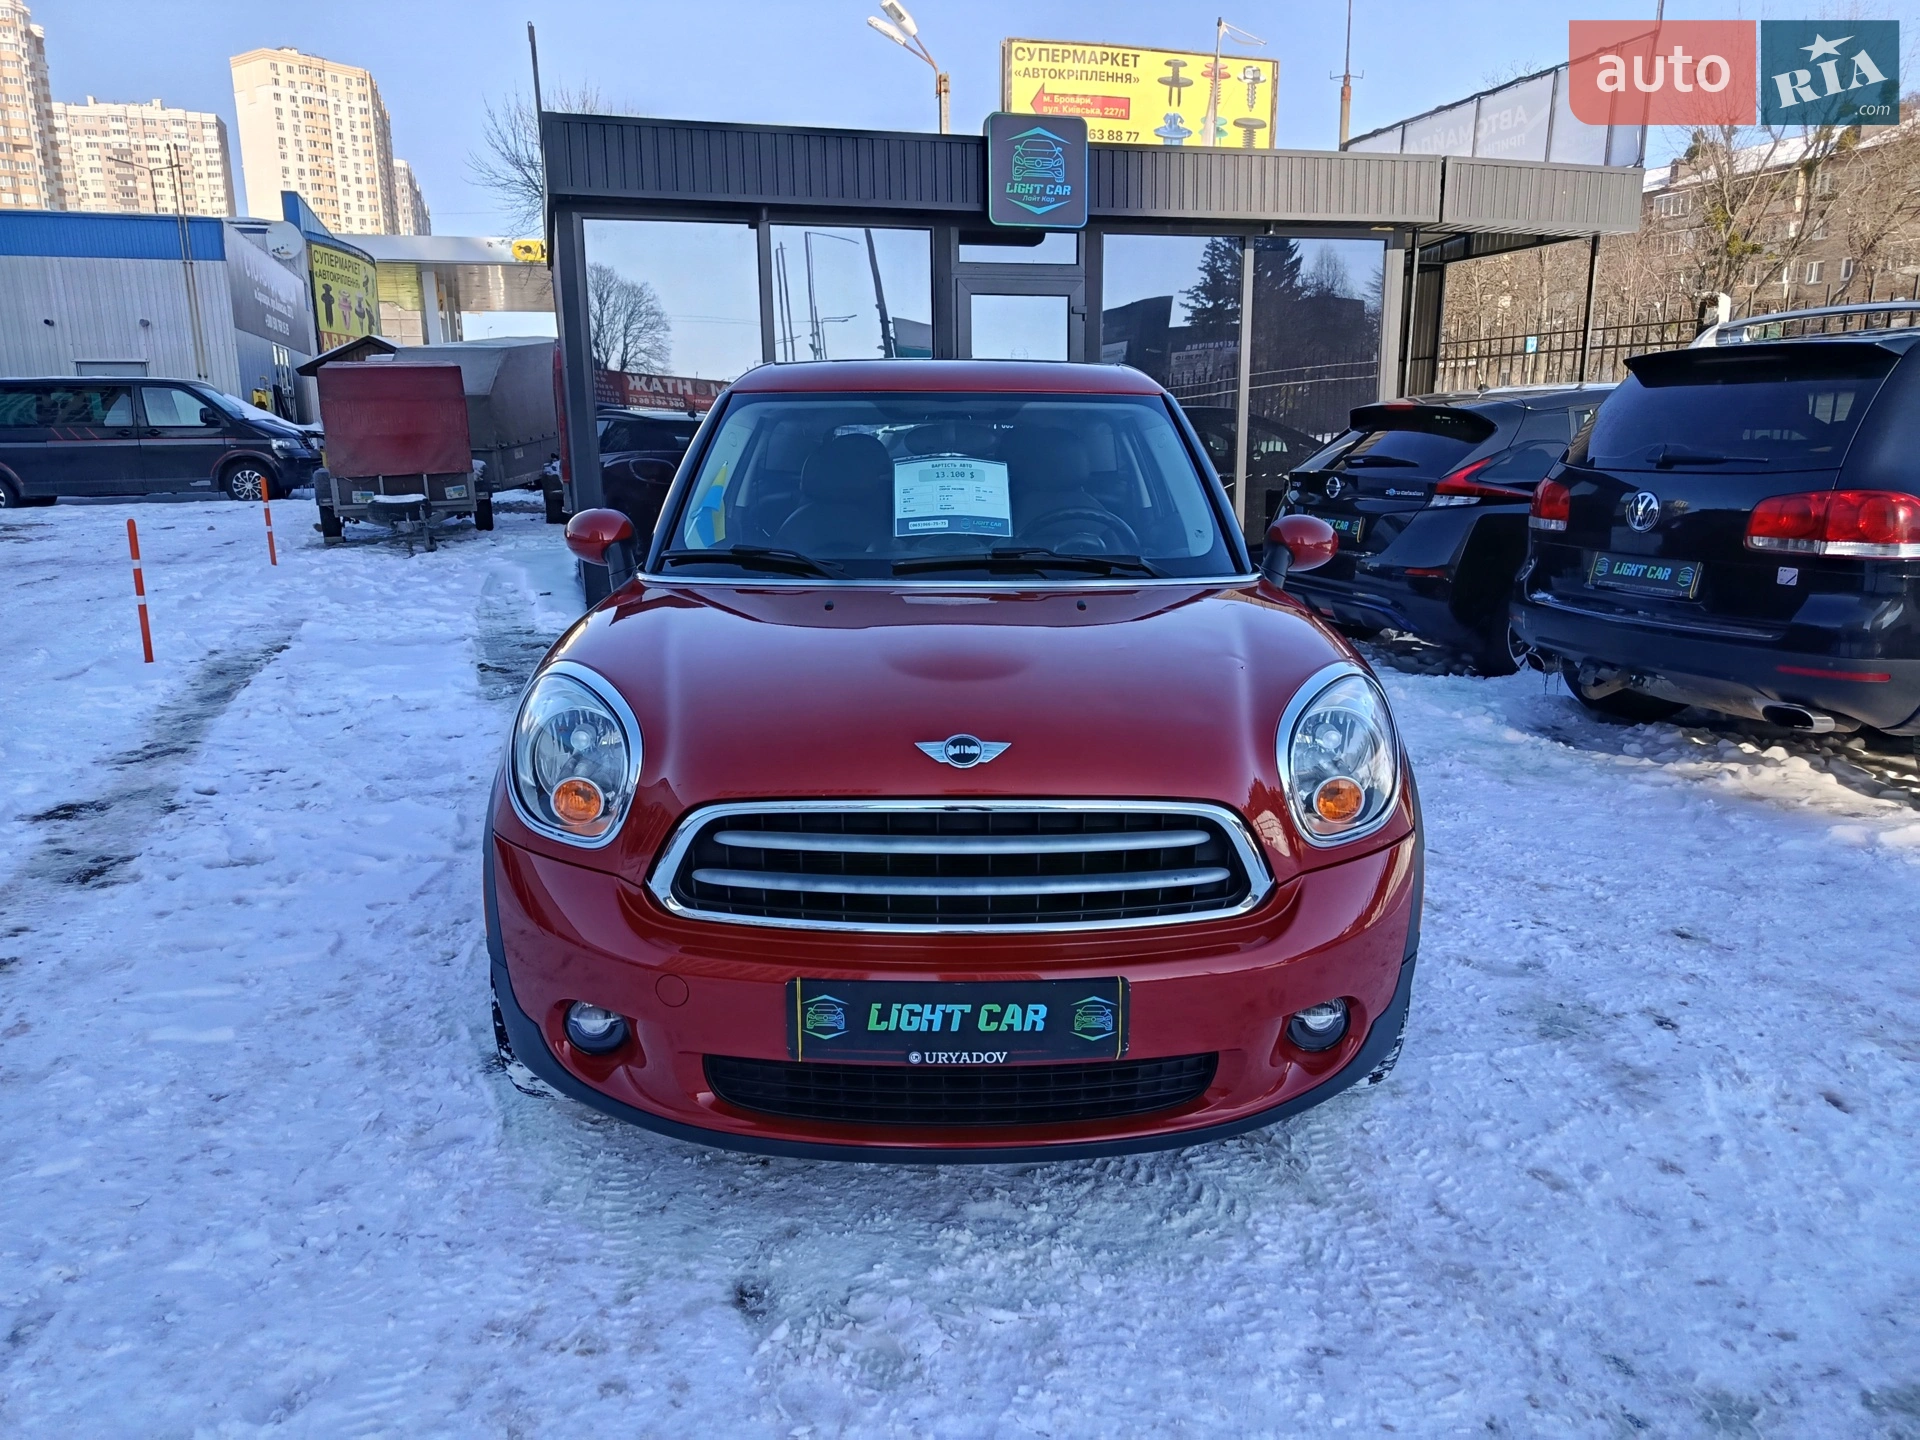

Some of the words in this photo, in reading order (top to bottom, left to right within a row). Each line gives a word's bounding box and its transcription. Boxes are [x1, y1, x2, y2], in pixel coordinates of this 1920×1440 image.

[1014, 46, 1140, 68] СУПЕРМАРКЕТ
[1053, 95, 1093, 105] Бровари,
[1043, 105, 1061, 113] вул.
[1062, 105, 1102, 115] Київська,
[1089, 129, 1105, 140] 63
[1107, 130, 1123, 141] 88
[1125, 131, 1140, 142] 77
[1006, 183, 1045, 195] LIGHT
[1045, 184, 1072, 196] CAR
[313, 249, 361, 276] СУПЕРМАРКЕТ
[936, 471, 965, 479] 13.100
[969, 471, 975, 479] $
[1335, 520, 1349, 531] CAR
[1613, 562, 1648, 577] LIGHT
[1646, 566, 1672, 580] CAR
[867, 1003, 972, 1032] LIGHT
[978, 1003, 1047, 1032] CAR
[925, 1052, 1008, 1064] URYADOV
